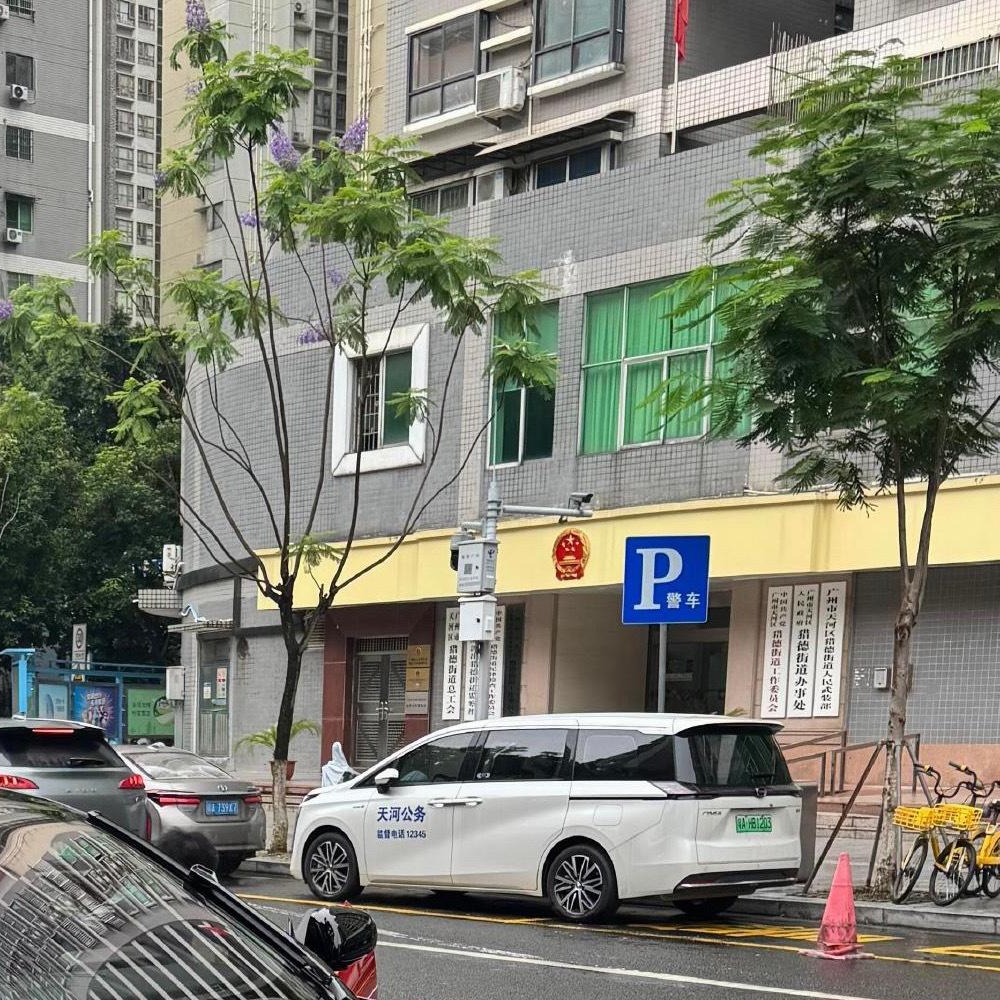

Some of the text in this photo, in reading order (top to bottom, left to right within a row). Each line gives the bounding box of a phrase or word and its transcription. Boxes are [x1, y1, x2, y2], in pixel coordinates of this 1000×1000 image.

[633, 547, 683, 610] P
[666, 592, 701, 609] 警车
[793, 629, 810, 711] 猎德街道办事处
[377, 806, 426, 822] 天河公务
[377, 829, 427, 839] 监督电话 12345
